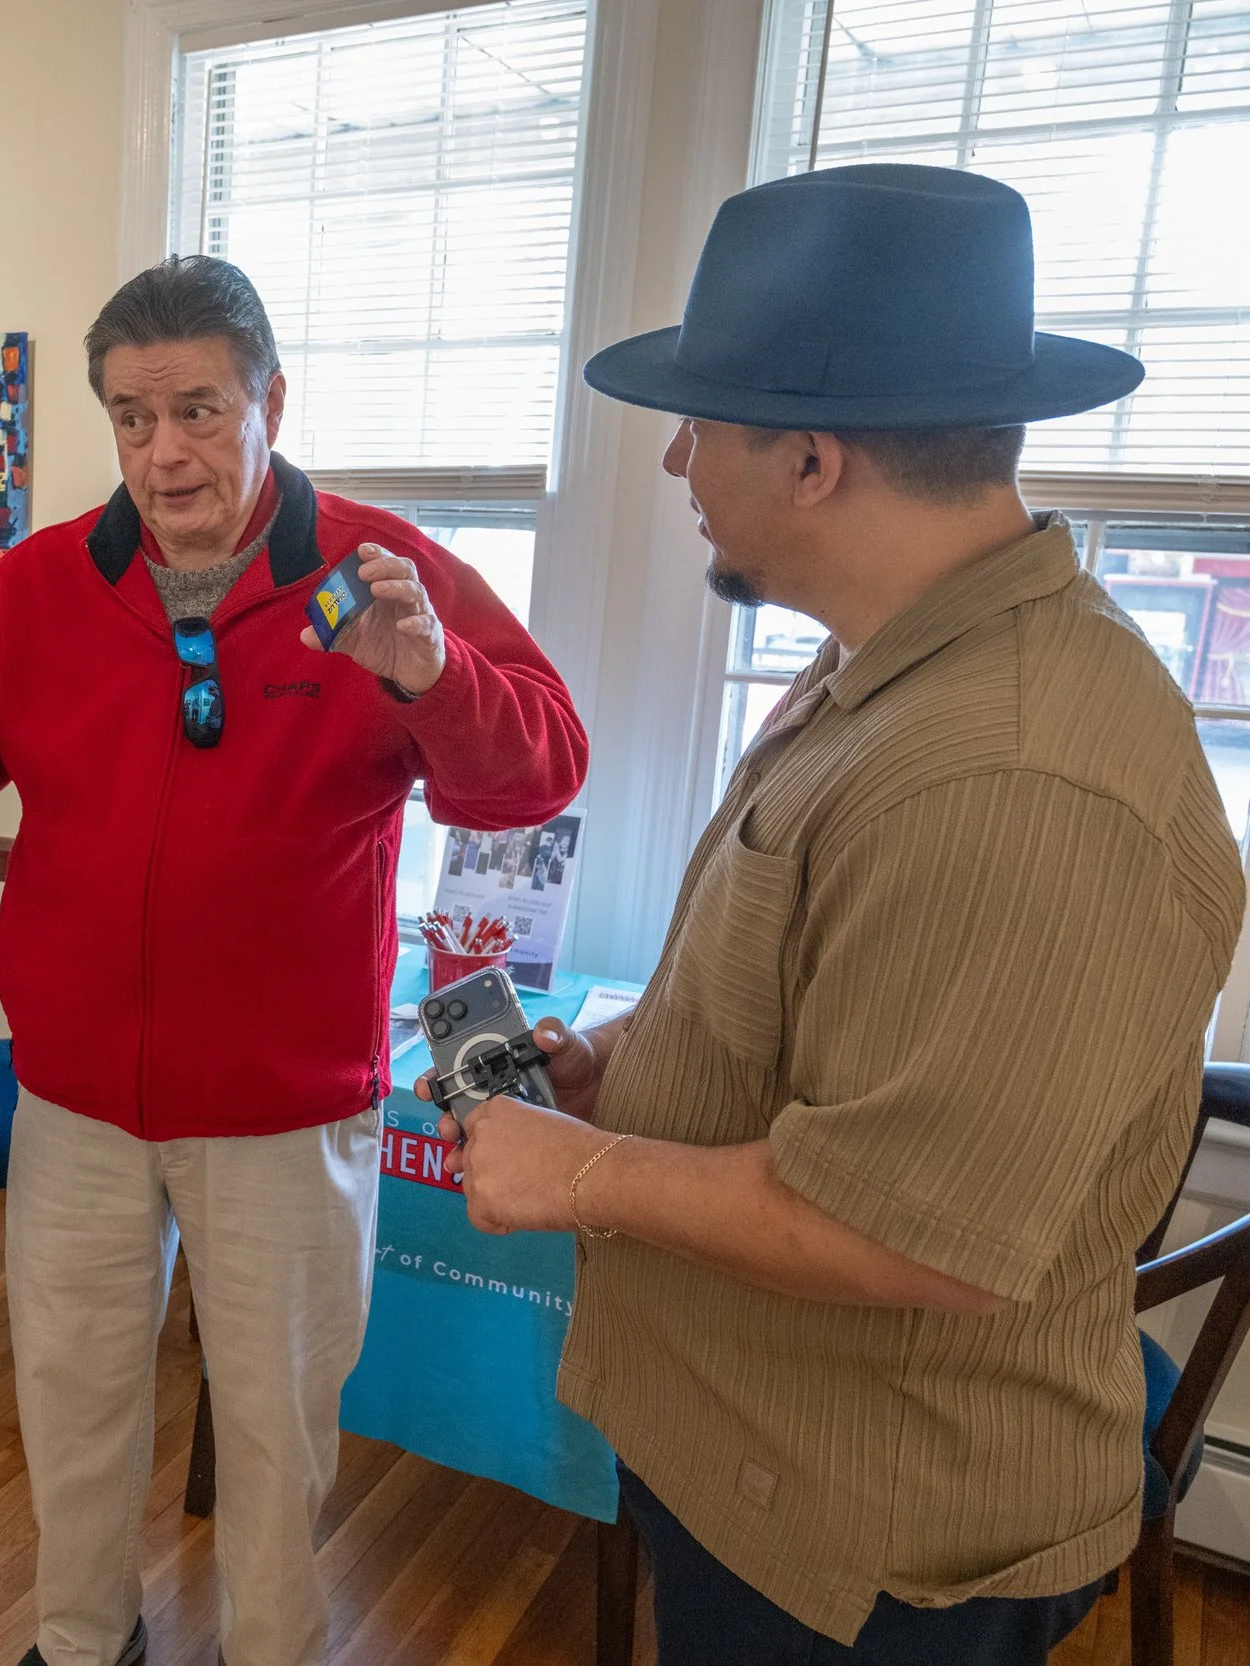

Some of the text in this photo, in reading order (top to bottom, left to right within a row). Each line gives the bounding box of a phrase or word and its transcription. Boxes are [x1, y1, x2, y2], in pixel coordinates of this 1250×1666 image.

[381, 1133, 463, 1184] HEN
[400, 1254, 423, 1269] of
[433, 1261, 573, 1317] Community
